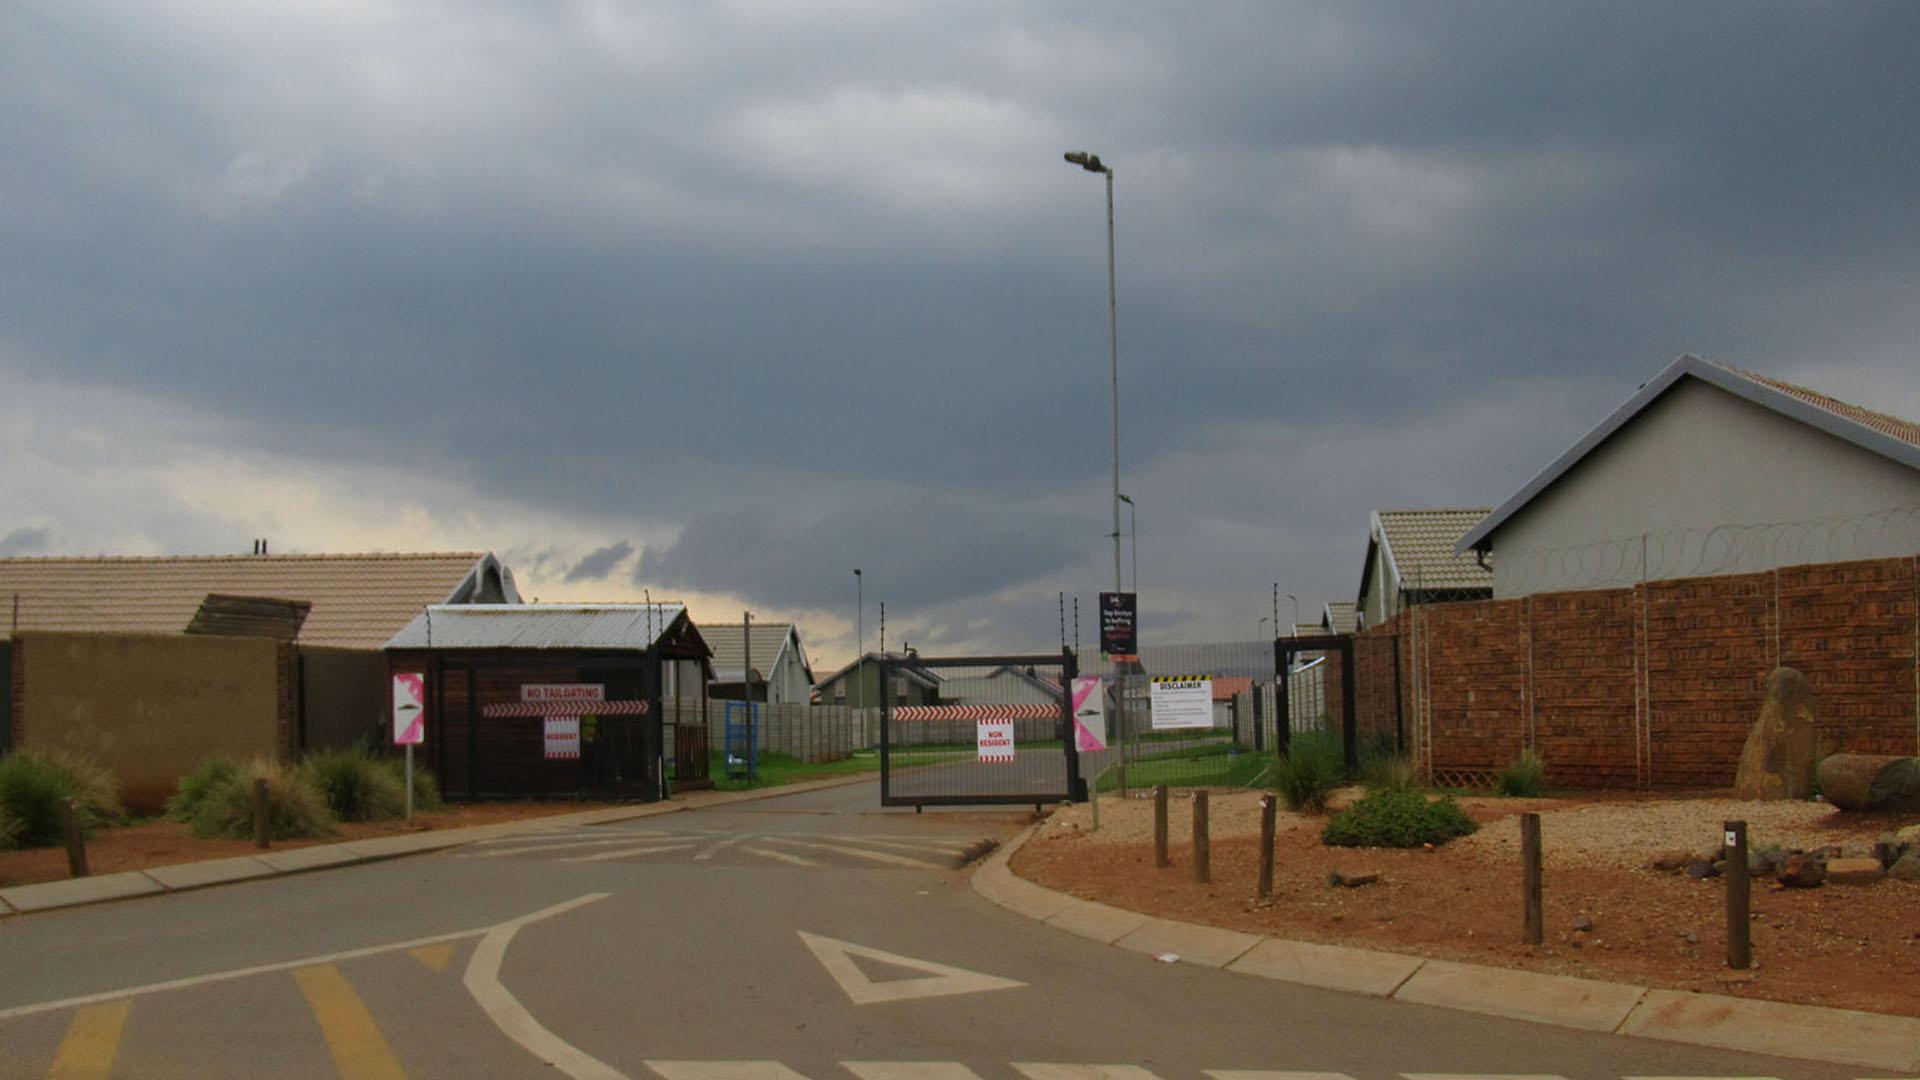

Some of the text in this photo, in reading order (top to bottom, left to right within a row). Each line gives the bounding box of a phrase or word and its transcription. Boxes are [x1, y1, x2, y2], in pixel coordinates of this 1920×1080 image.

[1160, 681, 1201, 690] DISCLAIMER
[528, 688, 599, 698] NO TAILGATING
[980, 739, 1010, 747] RESIDENT
